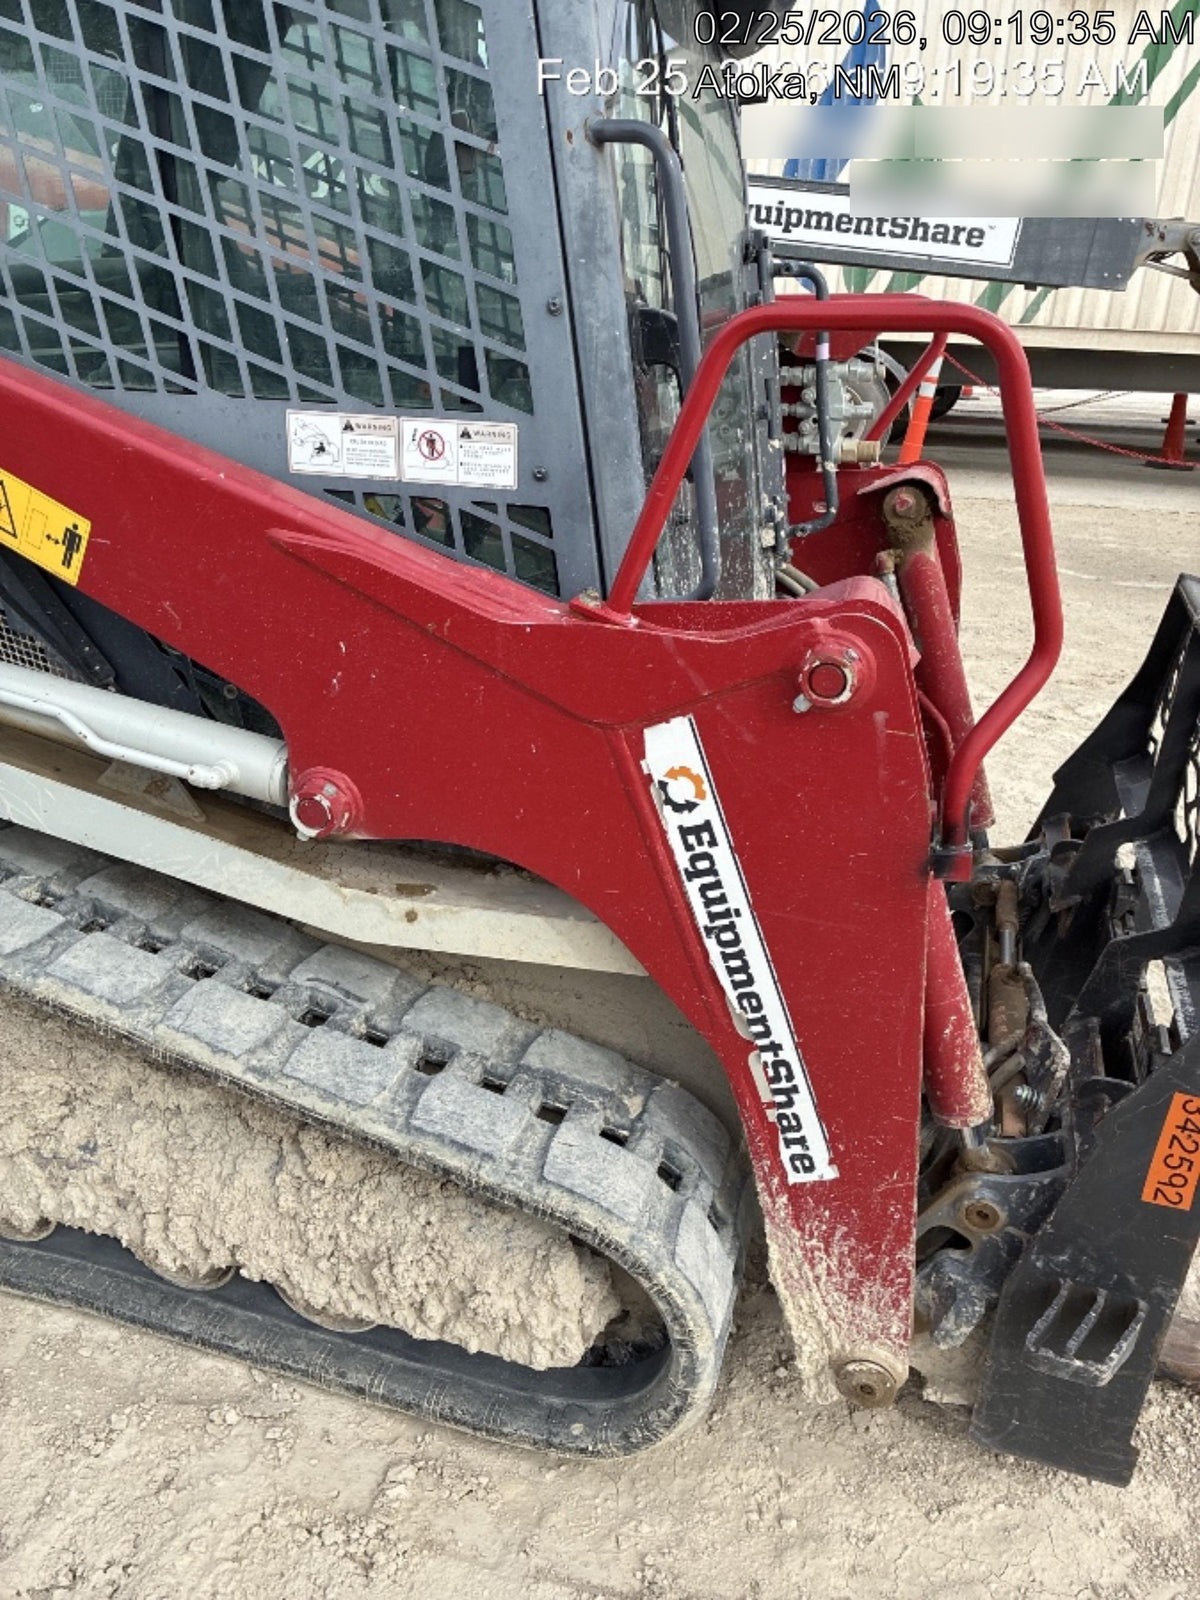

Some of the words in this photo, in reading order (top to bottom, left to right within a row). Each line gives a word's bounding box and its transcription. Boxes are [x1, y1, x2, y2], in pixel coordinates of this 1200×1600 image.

[748, 199, 986, 248] uipmentShare
[677, 819, 816, 1174] EquipmentShare
[1154, 1099, 1200, 1206] 342592
